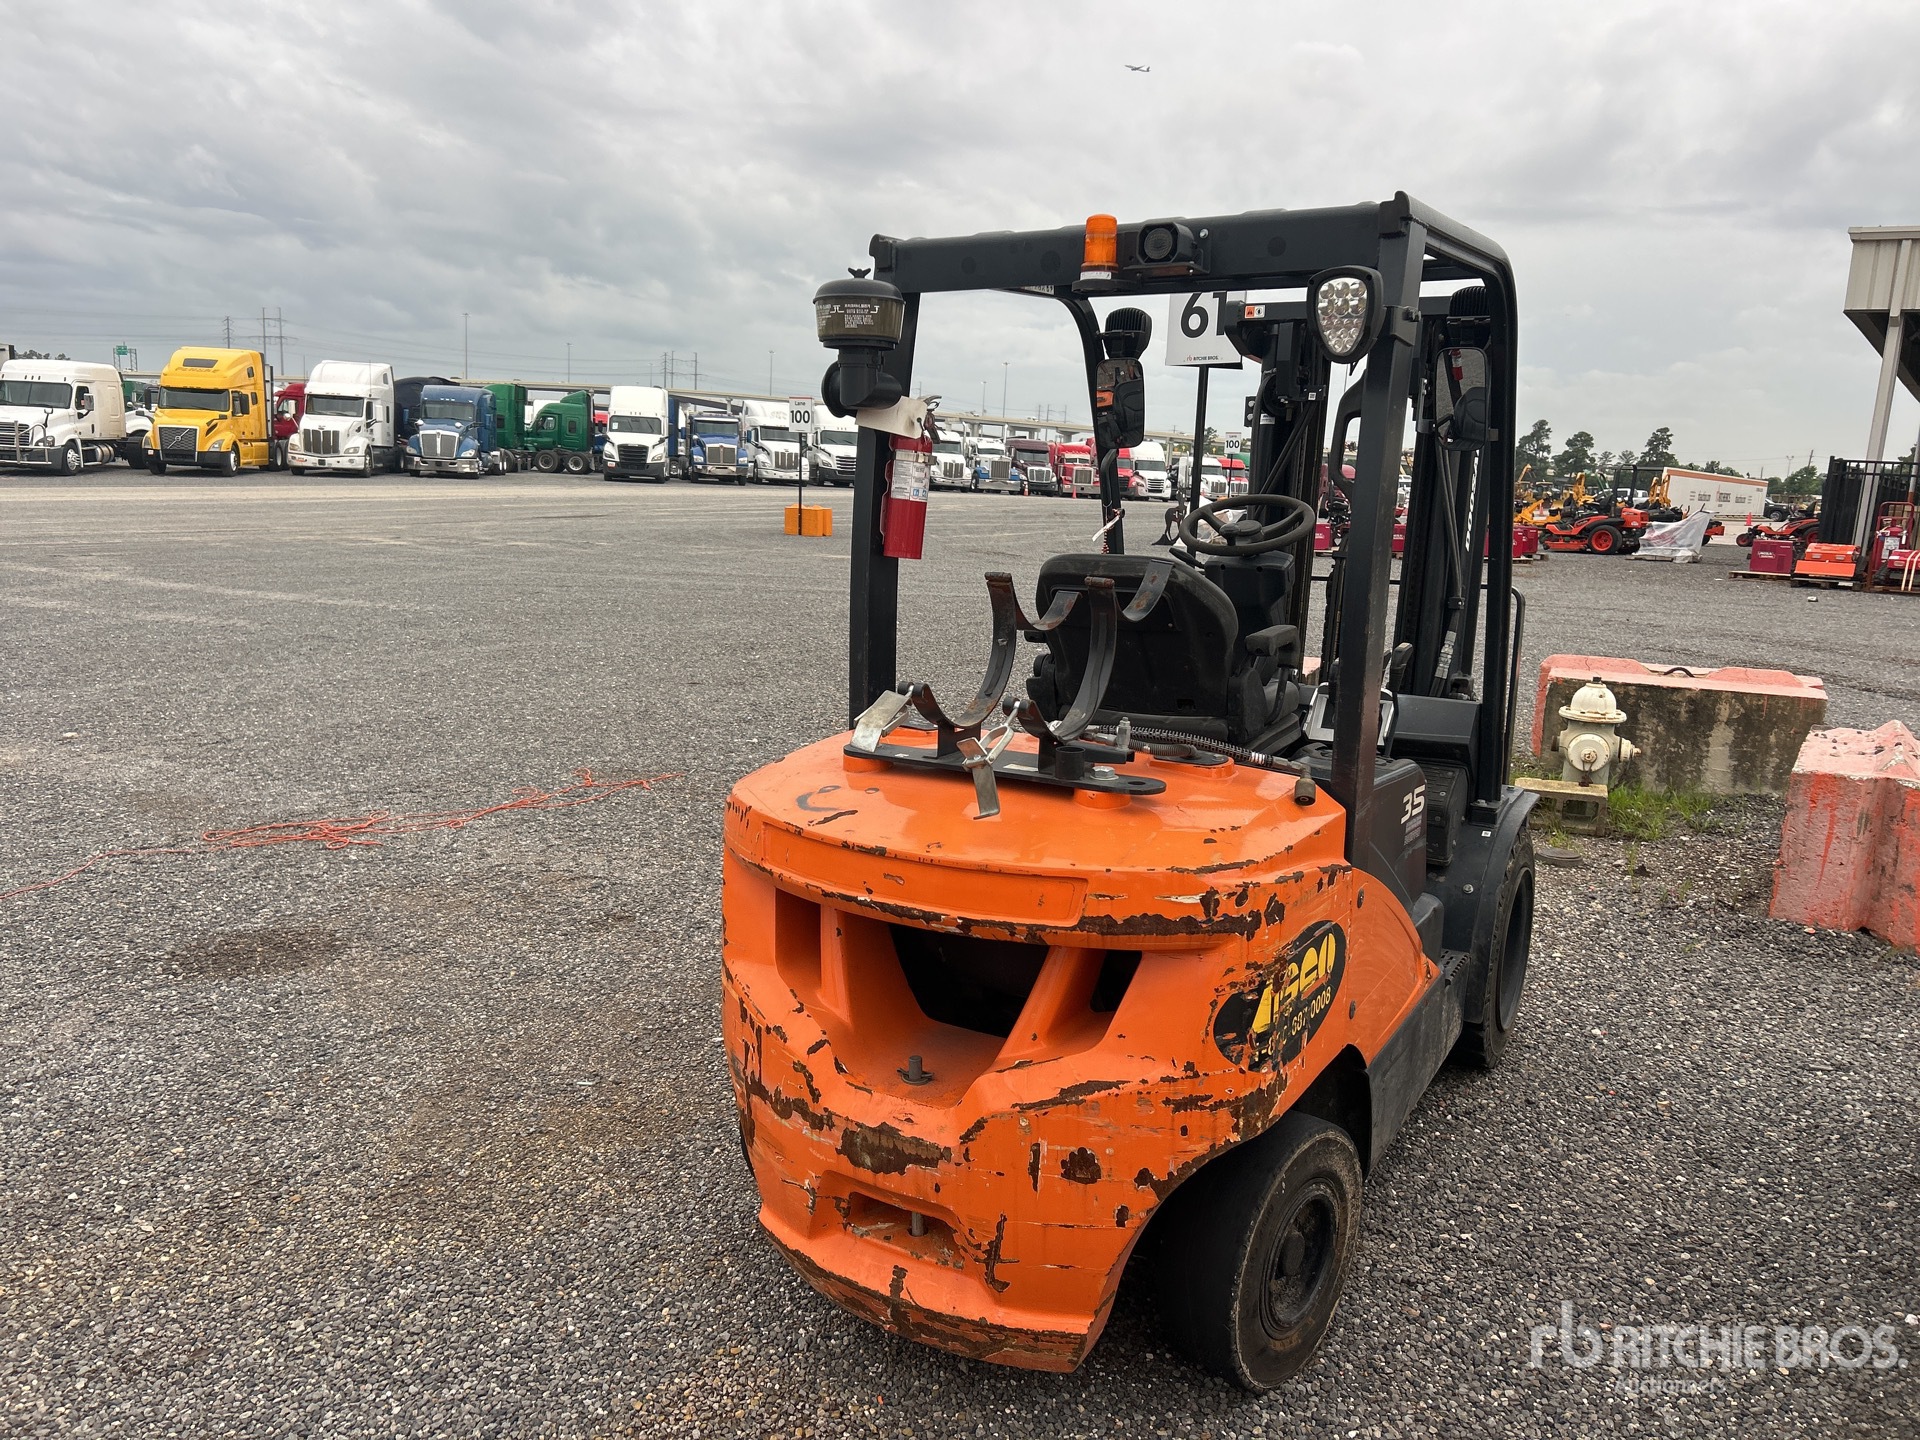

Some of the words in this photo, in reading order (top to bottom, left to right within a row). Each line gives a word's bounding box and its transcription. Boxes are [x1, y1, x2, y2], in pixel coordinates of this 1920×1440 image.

[790, 410, 811, 423] 100
[1226, 440, 1240, 449] 100
[1400, 784, 1426, 825] 35
